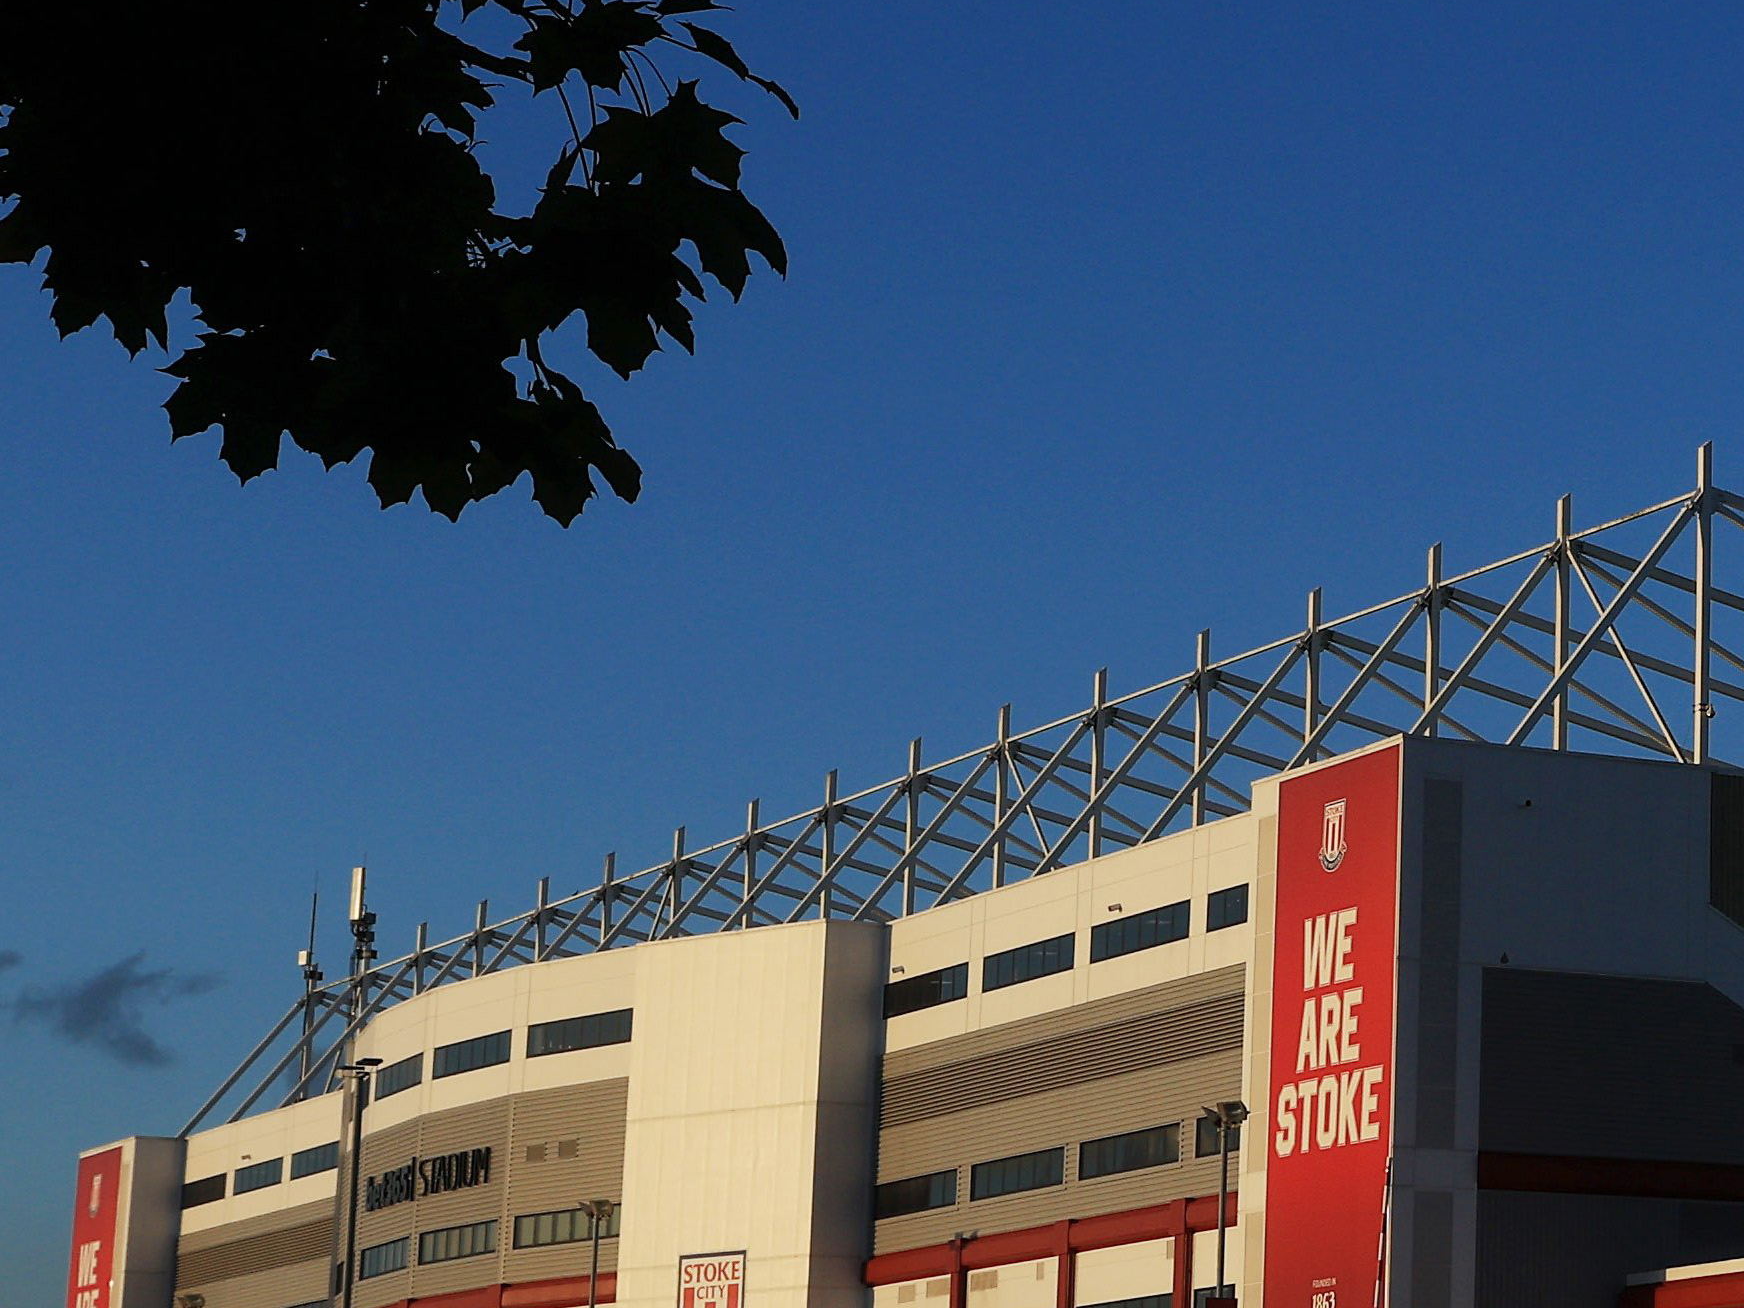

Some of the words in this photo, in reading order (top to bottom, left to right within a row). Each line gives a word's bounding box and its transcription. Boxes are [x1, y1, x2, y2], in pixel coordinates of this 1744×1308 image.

[1303, 906, 1358, 992] WE
[1295, 986, 1364, 1074] ARE
[1275, 1064, 1384, 1159] STOKE
[419, 1146, 491, 1196] STADIUM
[78, 1240, 101, 1289] WE
[684, 1261, 740, 1285] STOKE
[696, 1285, 726, 1300] CITY
